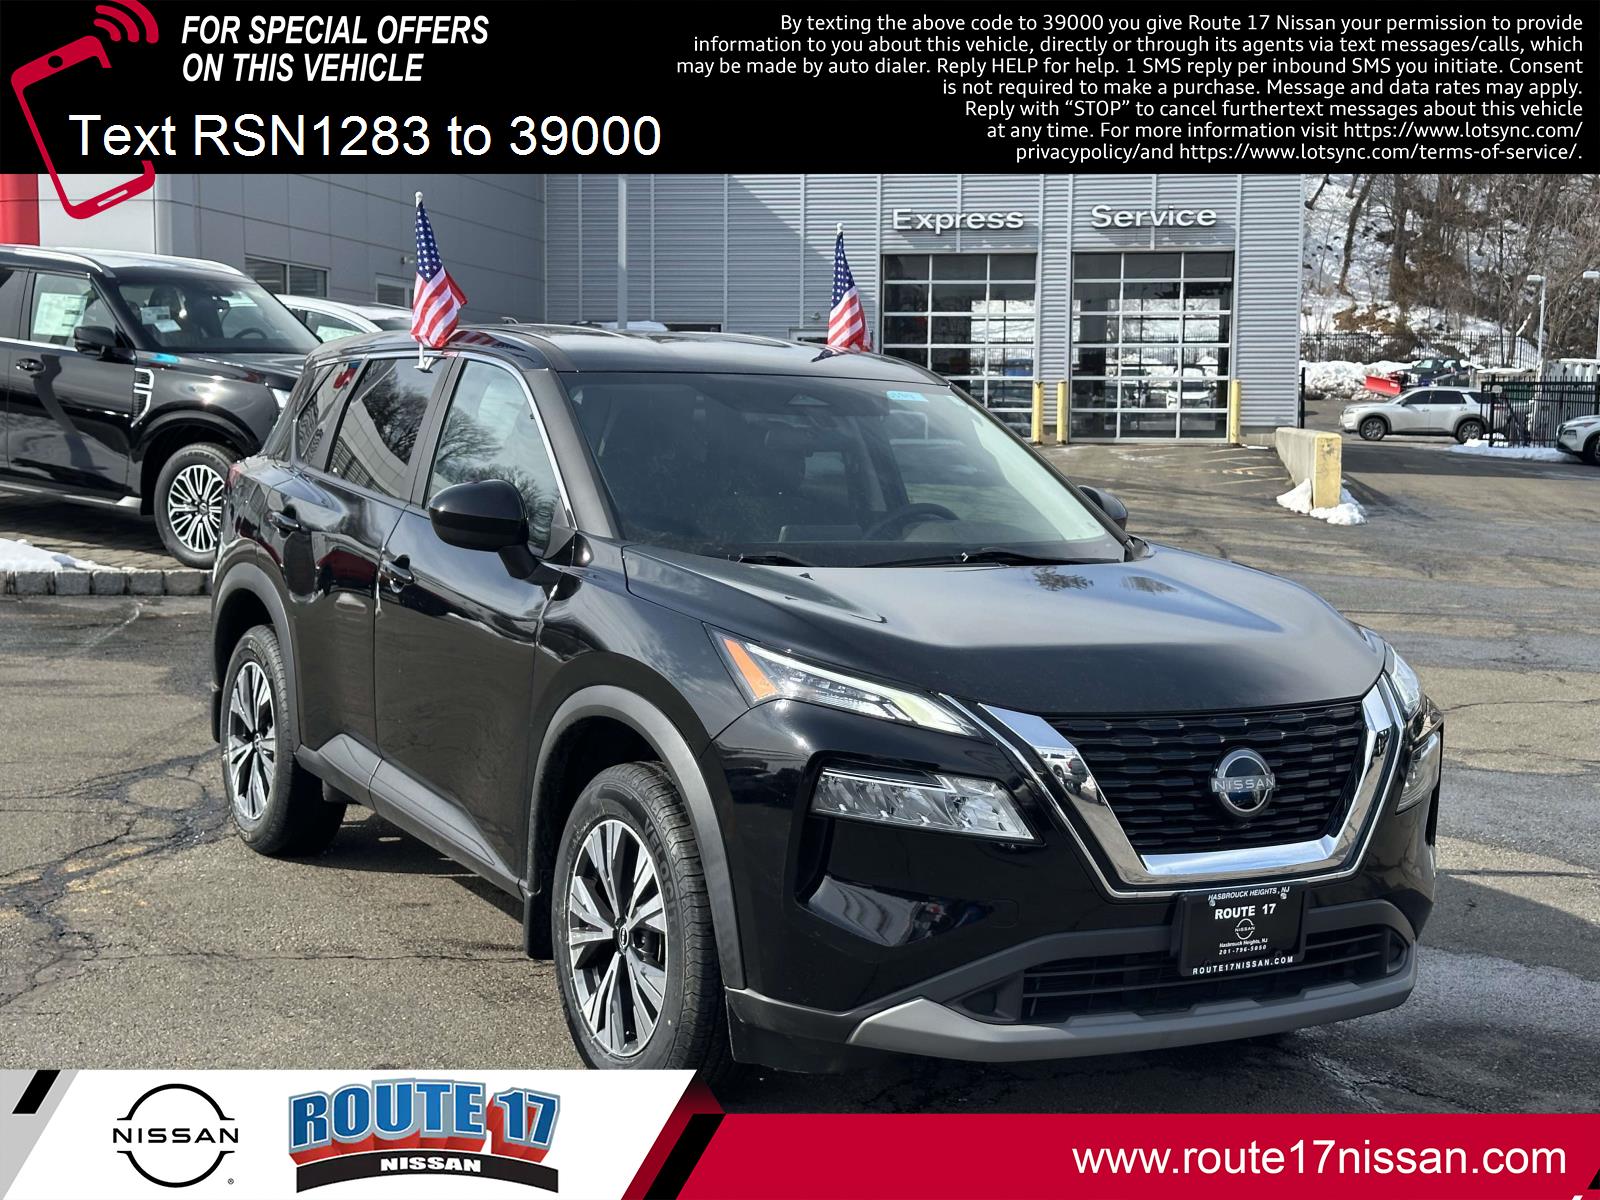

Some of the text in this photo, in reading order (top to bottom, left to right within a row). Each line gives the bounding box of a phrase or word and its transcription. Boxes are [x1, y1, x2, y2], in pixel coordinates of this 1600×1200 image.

[891, 207, 1024, 235] Express
[1090, 204, 1218, 228] Service
[1213, 777, 1275, 790] NISSAN
[1207, 890, 1249, 901] HASBROUCK
[1214, 902, 1277, 920] ROUTE 17
[1192, 955, 1294, 976] ROUTE17NISSAN.COM
